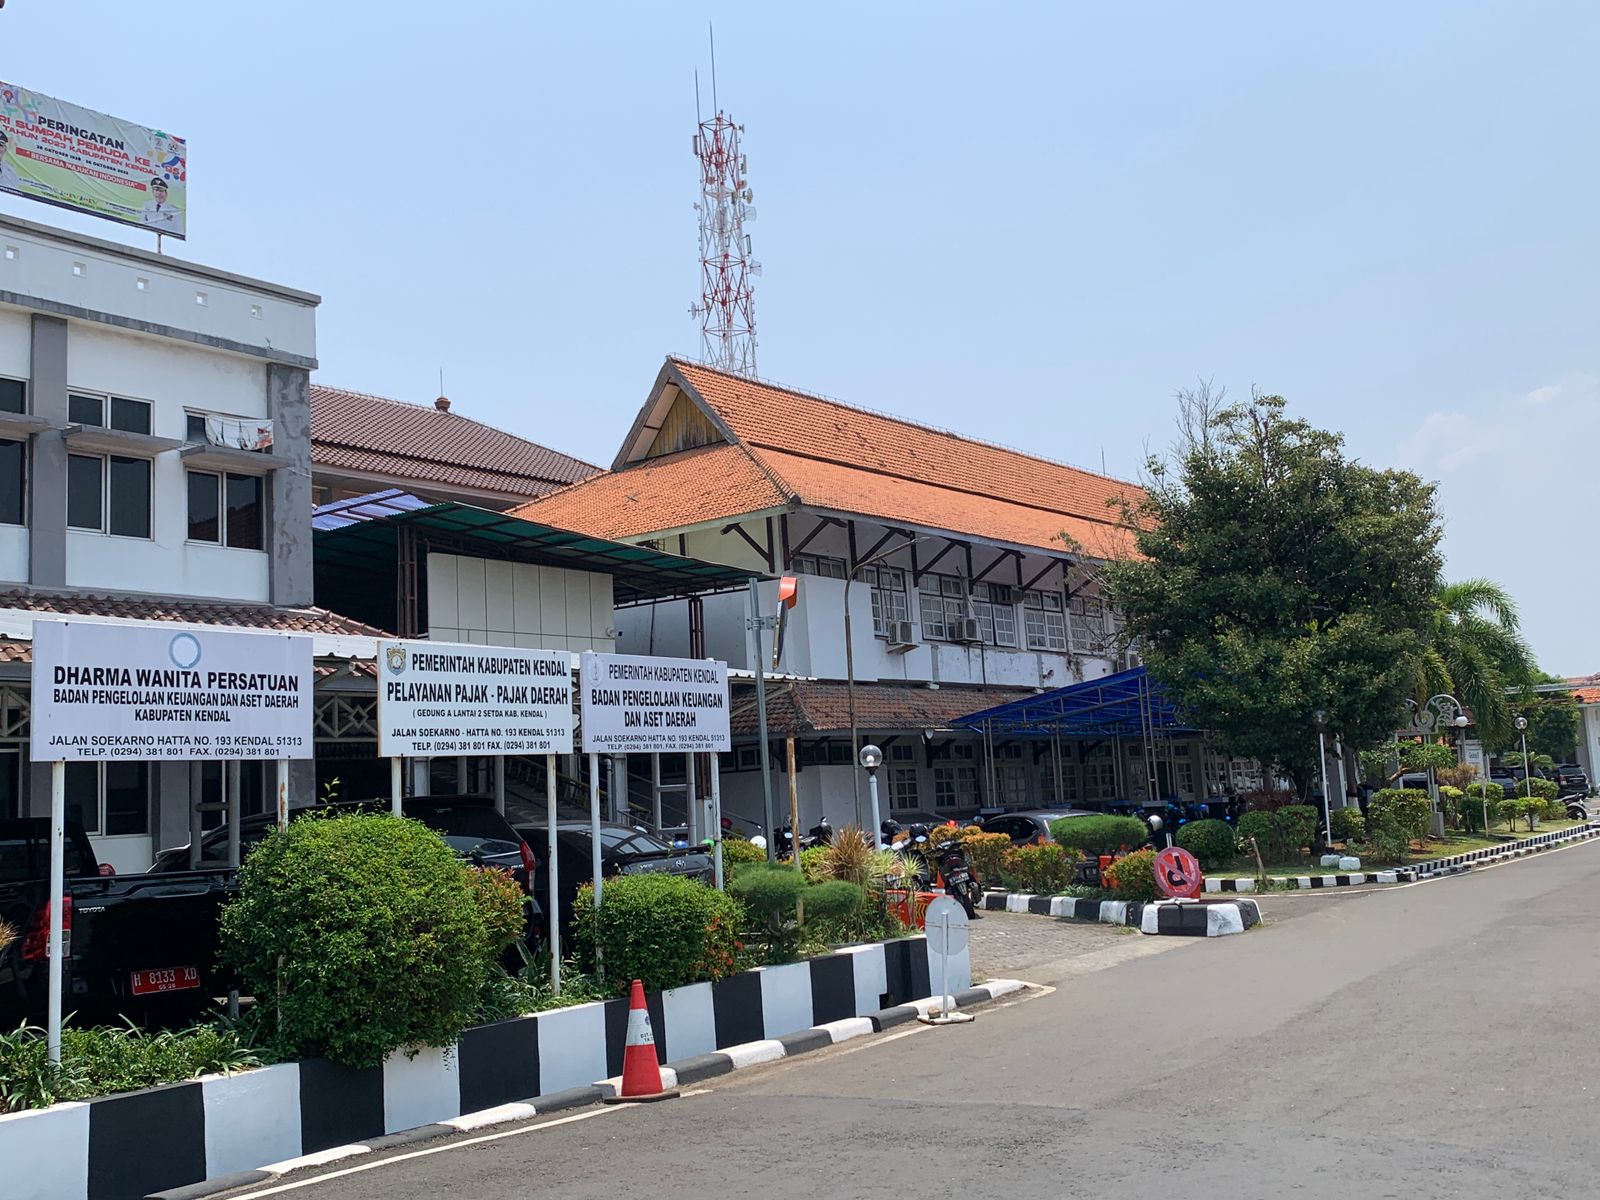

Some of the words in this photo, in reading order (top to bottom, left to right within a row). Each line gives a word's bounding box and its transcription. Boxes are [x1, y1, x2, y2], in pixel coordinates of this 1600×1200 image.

[38, 116, 124, 150] PERINGATAN
[3, 124, 38, 141] TAHUN
[41, 137, 66, 149] 2023
[69, 145, 122, 166] KABUPATEN
[125, 162, 159, 176] KENDAL
[16, 120, 73, 144] SUMPAH
[77, 138, 130, 161] PEMUDA
[135, 156, 150, 167] KE
[412, 653, 475, 673] PEMERINTAH
[478, 657, 531, 675] KABUPATEN
[533, 659, 567, 676] KENDAL
[609, 664, 653, 681] PEMERINTAH
[654, 666, 692, 683] KABUPATEN
[693, 668, 719, 684] KENDAL
[54, 666, 132, 687] DHARMA
[136, 669, 202, 688] WANITA
[207, 672, 298, 692] PERSATUAN
[53, 689, 89, 703] BADAN
[92, 690, 164, 705] PENGELOLAAN
[167, 692, 218, 706] KEUANGAN
[220, 693, 238, 707] DAN
[240, 694, 262, 708] ASET
[264, 695, 298, 708] DAERAH
[387, 682, 452, 702] PELAYANAN
[455, 684, 488, 703] PAJAK
[497, 685, 528, 703] PAJAK
[531, 686, 568, 705] DAERAH
[591, 689, 620, 706] BADAN
[622, 690, 680, 707] PENGELOLAAN
[682, 691, 722, 708] KEUANGAN
[135, 709, 191, 721] KABUPATEN
[195, 710, 231, 722] KENDAL
[417, 709, 445, 717] GEDUNG
[447, 709, 452, 717] A
[453, 709, 476, 717] LANTAI
[478, 709, 482, 717] 2
[483, 709, 503, 717] SETDA
[505, 710, 519, 718] KAB.
[520, 710, 543, 718] KENDAL
[624, 711, 641, 727] DAN
[643, 711, 663, 727] ASET
[665, 712, 697, 727] DAERAH
[49, 735, 88, 746] JALAN
[91, 735, 154, 746] SOEKARNO
[157, 736, 191, 745] HATTA
[194, 736, 212, 746] NO.
[216, 736, 231, 746] 193
[234, 736, 274, 746] KENDAL
[276, 736, 302, 746] 51313
[392, 728, 417, 737] JALAN
[419, 728, 460, 737] SOEKARNO
[466, 728, 489, 737] HATTA
[491, 728, 503, 737] NO.
[505, 728, 517, 736] 193
[518, 728, 544, 736] KENDAL
[546, 728, 565, 736] 51313
[592, 735, 613, 743] JALAN
[614, 734, 647, 742] SOEKARNO
[648, 734, 666, 742] HATTA
[667, 734, 677, 742] NO.
[688, 734, 710, 742] KENDAL
[77, 748, 107, 756] TELP.
[110, 747, 142, 757] (0294)
[146, 748, 162, 756] 381
[166, 748, 183, 756] 801
[215, 747, 243, 757] (0294)
[246, 748, 262, 756] 381
[264, 748, 280, 756] 801
[412, 742, 432, 751] TELP.
[434, 741, 456, 751] (0294)
[458, 742, 470, 750] 381
[472, 741, 485, 750] 801
[487, 741, 502, 750] FAX.
[504, 741, 524, 751] (0294)
[526, 741, 537, 750] 381
[539, 741, 550, 749] 801
[78, 906, 106, 914] TOYOTA
[133, 973, 142, 987] H
[149, 969, 176, 985] 8133
[184, 967, 198, 981] XD
